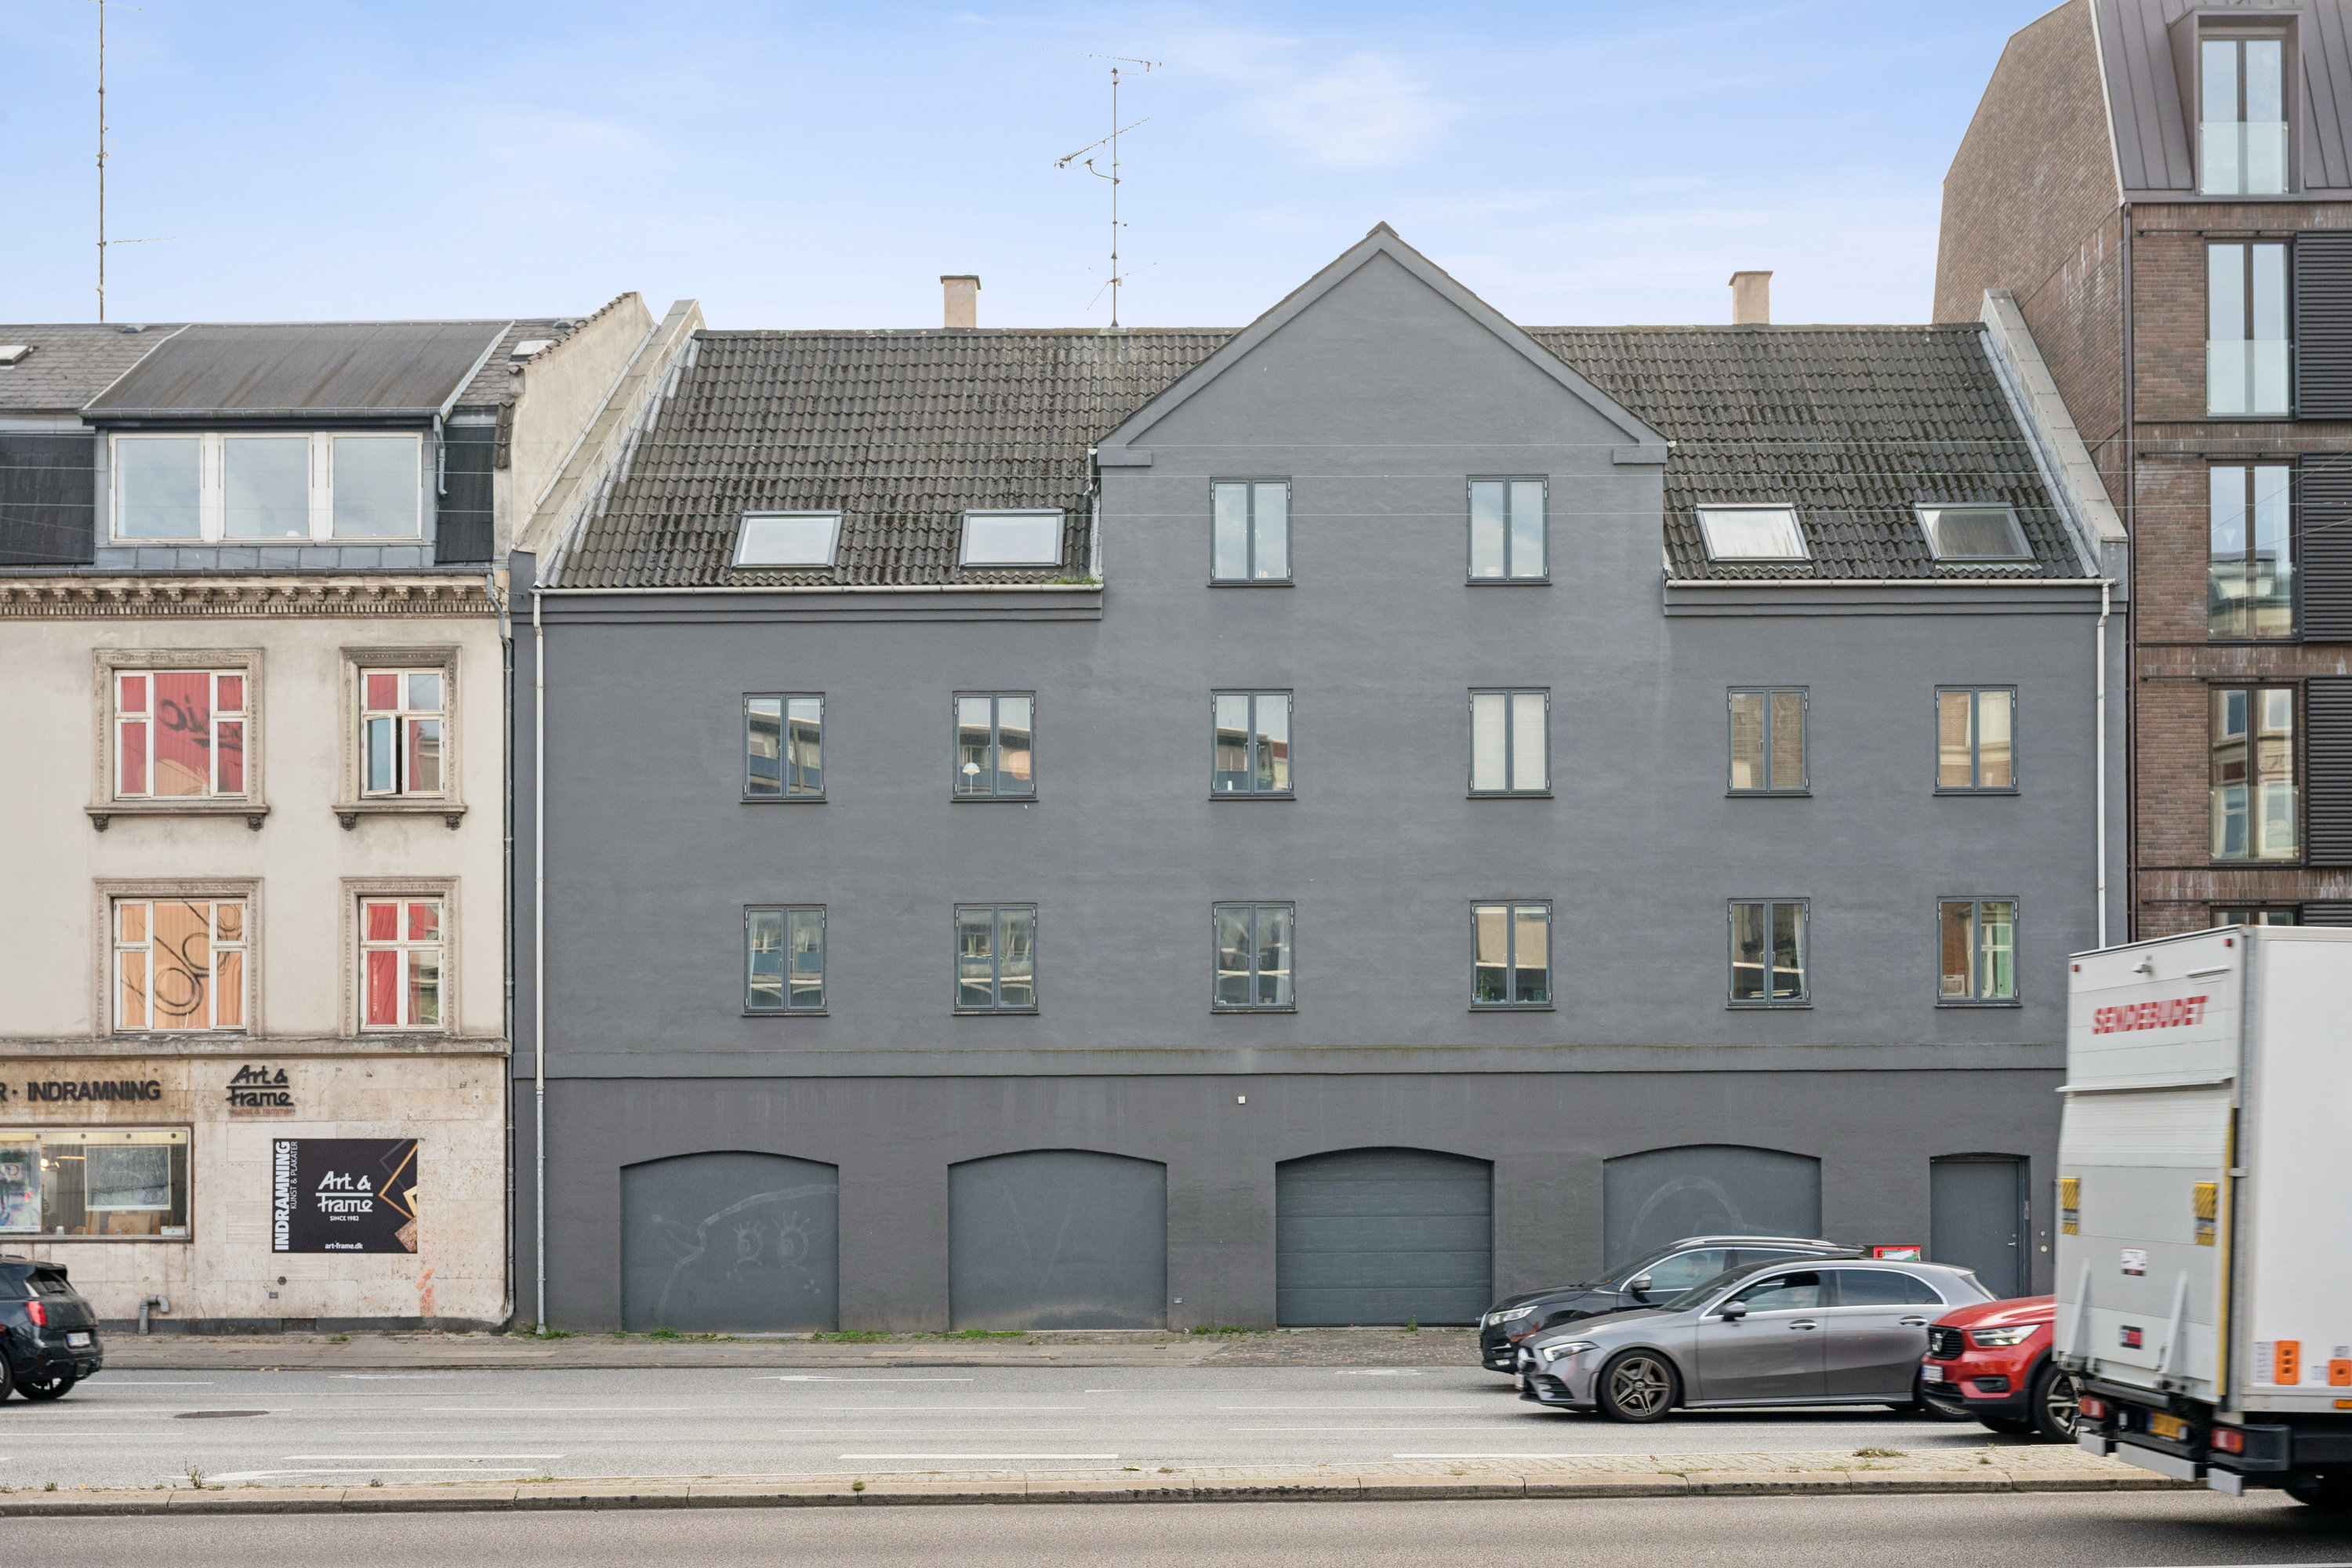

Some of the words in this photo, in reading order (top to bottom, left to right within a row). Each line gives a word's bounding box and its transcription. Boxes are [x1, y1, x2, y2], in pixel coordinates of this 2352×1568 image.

[230, 1065, 271, 1083] Art
[274, 1069, 288, 1083] &
[27, 1080, 161, 1102] INDRAMNING
[318, 1171, 354, 1190] Art
[357, 1175, 371, 1190] &
[274, 1141, 290, 1250] INDRAMNING
